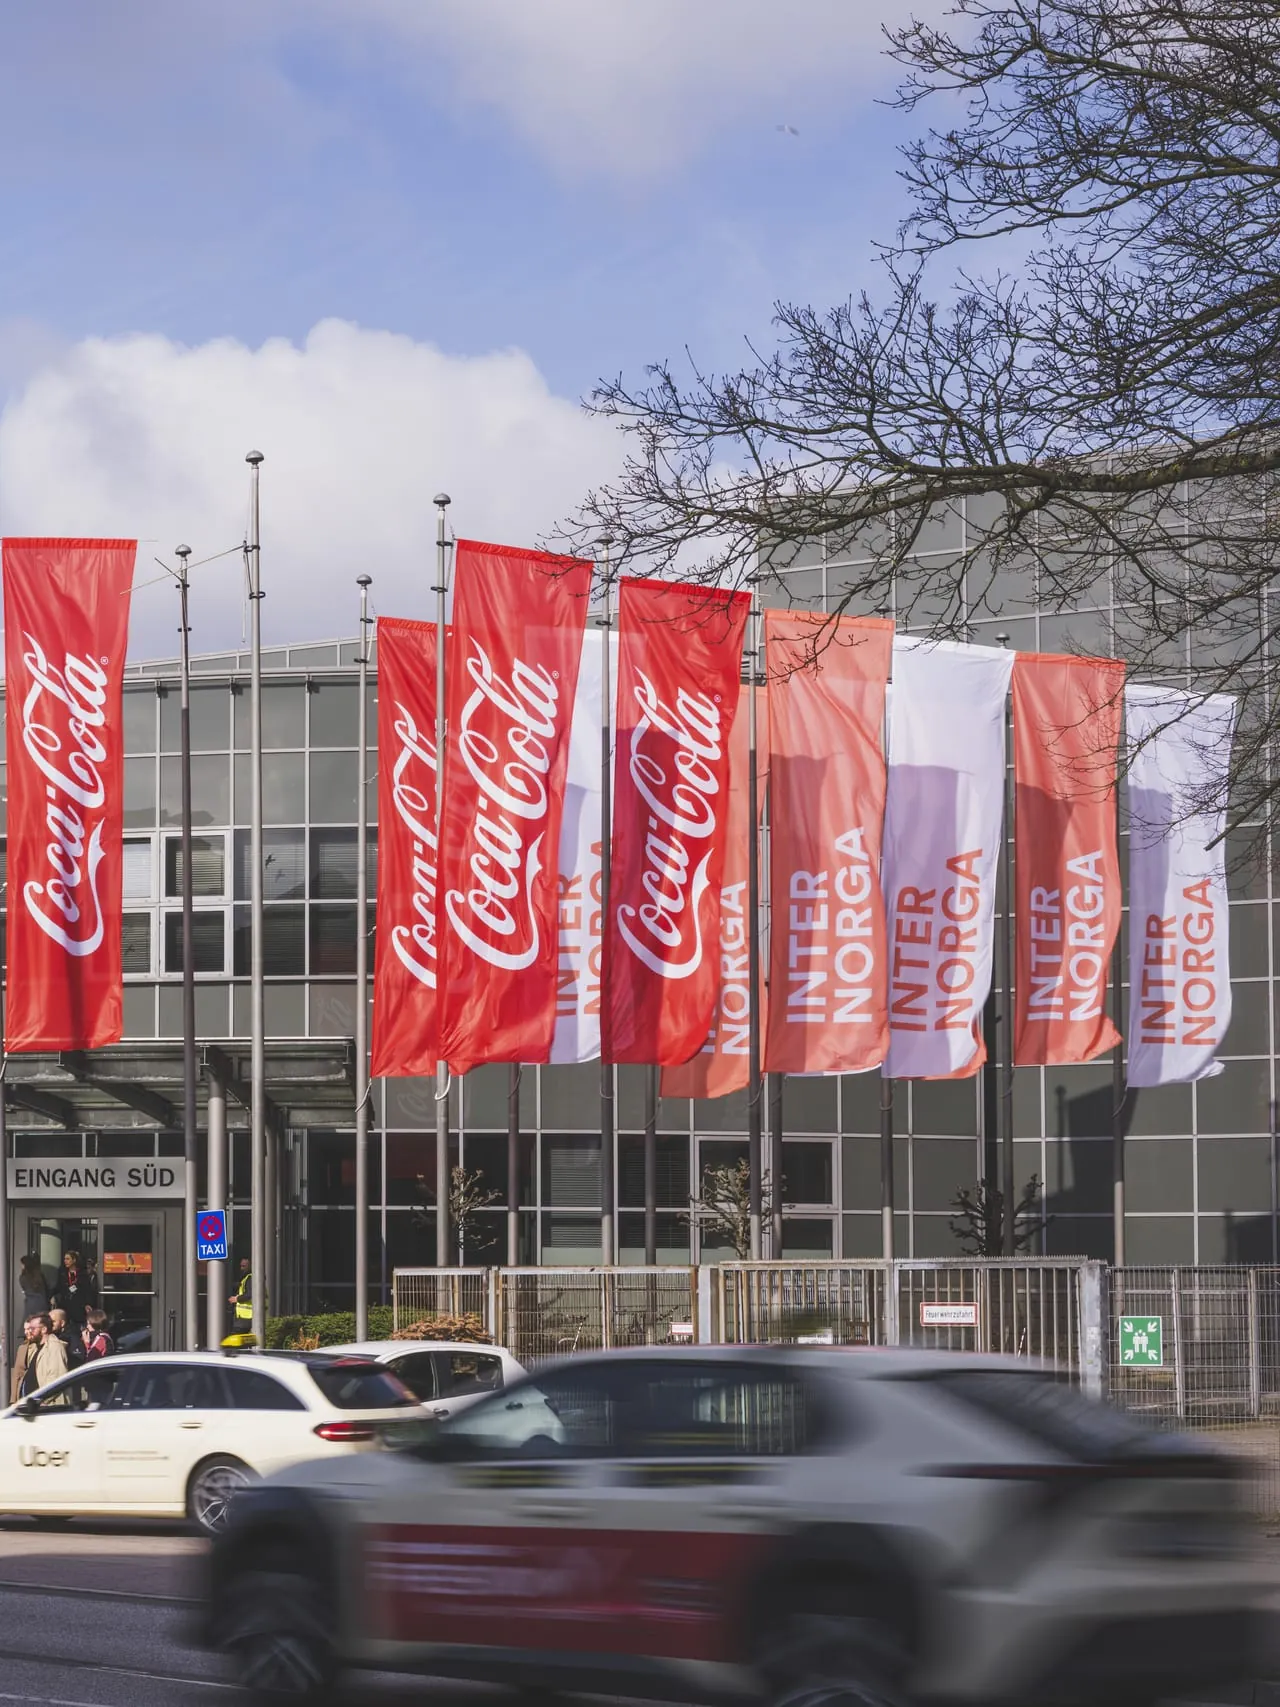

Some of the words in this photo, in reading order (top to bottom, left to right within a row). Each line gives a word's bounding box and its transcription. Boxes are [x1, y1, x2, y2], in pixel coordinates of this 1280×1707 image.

[22, 631, 109, 957] Coca-Cola
[445, 635, 558, 971] Coca-Cola
[617, 665, 722, 979] Coca-Cola
[720, 880, 750, 1055] NORGA
[786, 870, 829, 1023] INTER
[833, 826, 874, 1023] NORGA
[889, 886, 936, 1032] INTER
[934, 848, 983, 1031] NORGA
[1027, 886, 1064, 1021] INTER
[1066, 850, 1105, 1021] NORGA
[1141, 914, 1177, 1045] INTER
[1182, 878, 1217, 1046] NORGA
[15, 1168, 116, 1188] EINGANG
[127, 1163, 175, 1188] SÜD
[200, 1243, 224, 1255] TAXI
[19, 1445, 70, 1467] Uber
